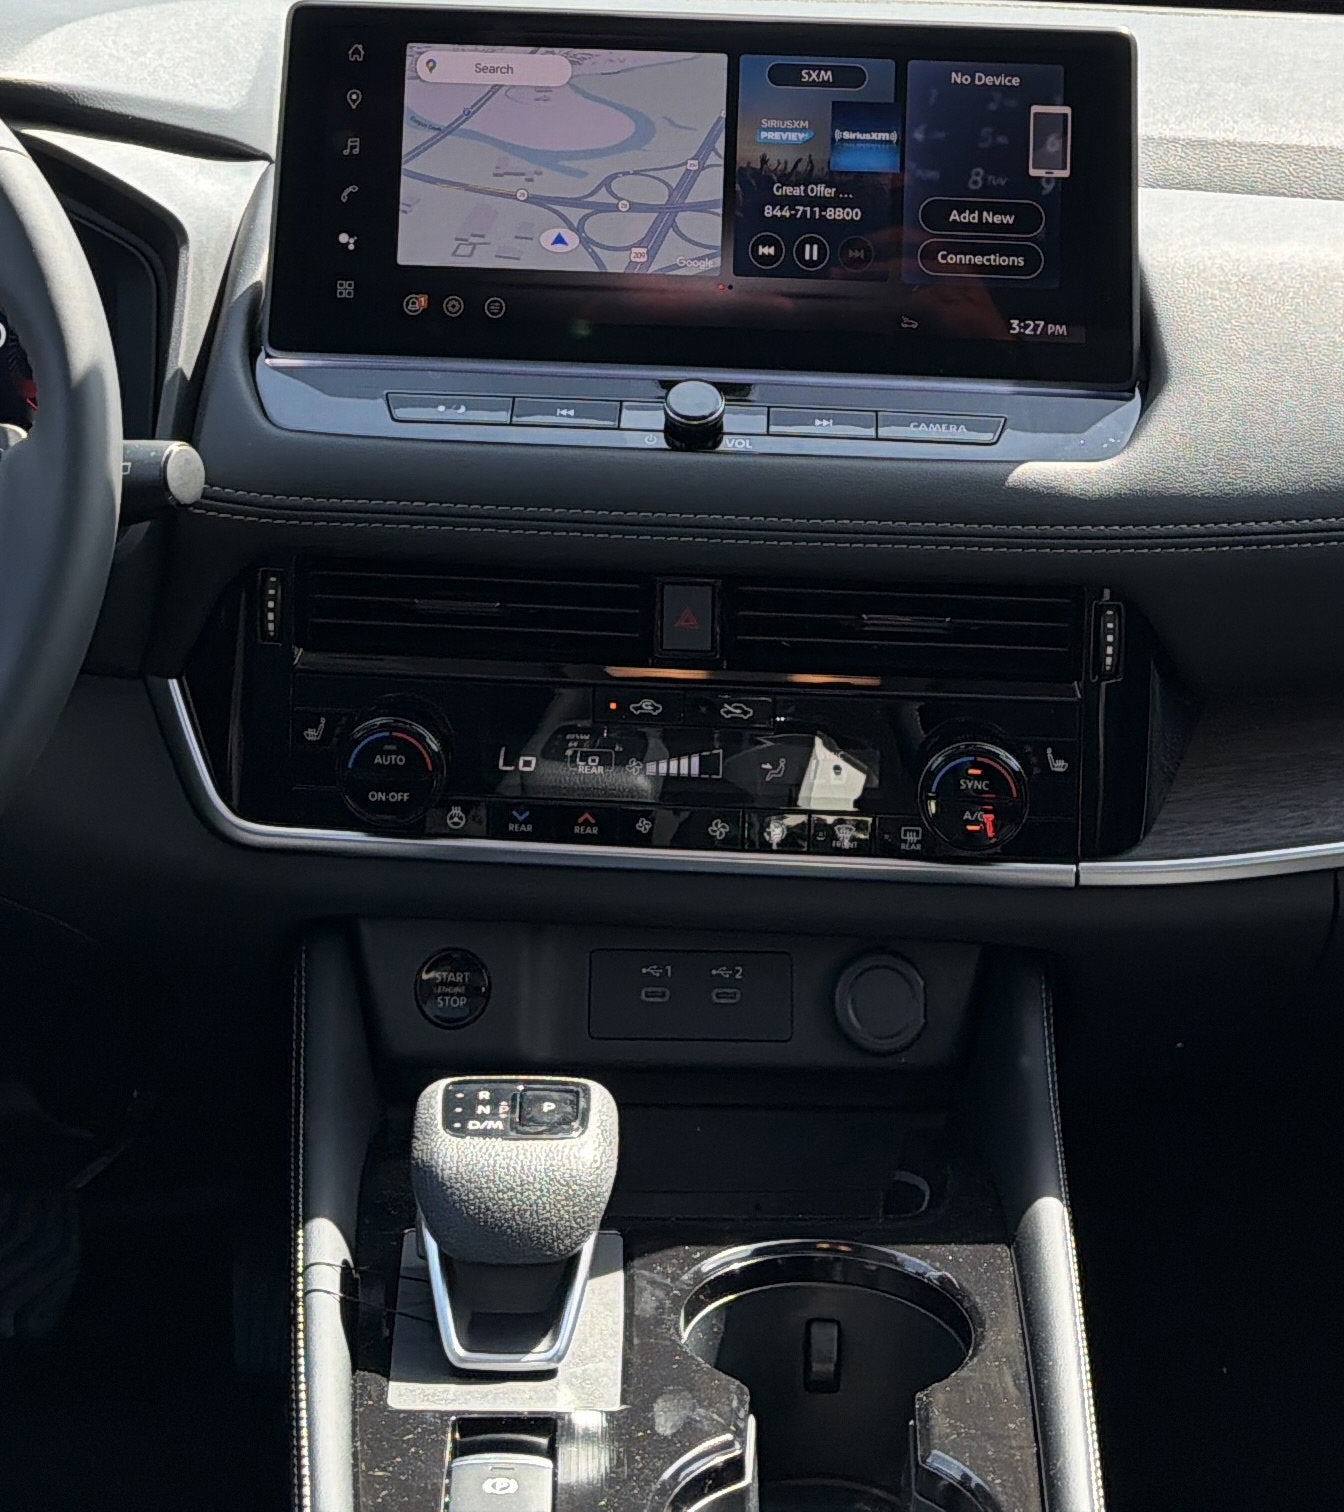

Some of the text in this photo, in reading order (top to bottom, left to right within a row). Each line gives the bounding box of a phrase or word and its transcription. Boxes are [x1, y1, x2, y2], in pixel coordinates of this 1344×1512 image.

[474, 62, 514, 75] Search
[801, 69, 833, 83] SXM
[951, 72, 1020, 86] No Device
[761, 118, 808, 129] SIRIUSXM
[773, 183, 836, 197] Great Offer
[764, 205, 861, 221] 844-711-8800
[949, 210, 1015, 225] Add New
[632, 251, 646, 259] 209
[937, 250, 1024, 267] Connections
[676, 256, 714, 269] Google
[1009, 319, 1067, 336] 3:27 PM
[909, 421, 967, 434] CAMERA
[726, 438, 752, 449] VOL
[374, 754, 406, 766] AUTO
[577, 766, 604, 774] REAR
[960, 779, 989, 790] SYNC
[963, 811, 984, 821] A/C
[509, 823, 533, 832] REAR
[574, 825, 598, 834] REAR
[901, 842, 921, 850] REAR
[436, 971, 470, 983] START
[735, 966, 743, 978] 2
[437, 996, 467, 1007] STOP
[478, 1091, 490, 1100] R
[477, 1105, 490, 1114] N
[543, 1102, 556, 1112] P
[467, 1120, 504, 1130] D/M
